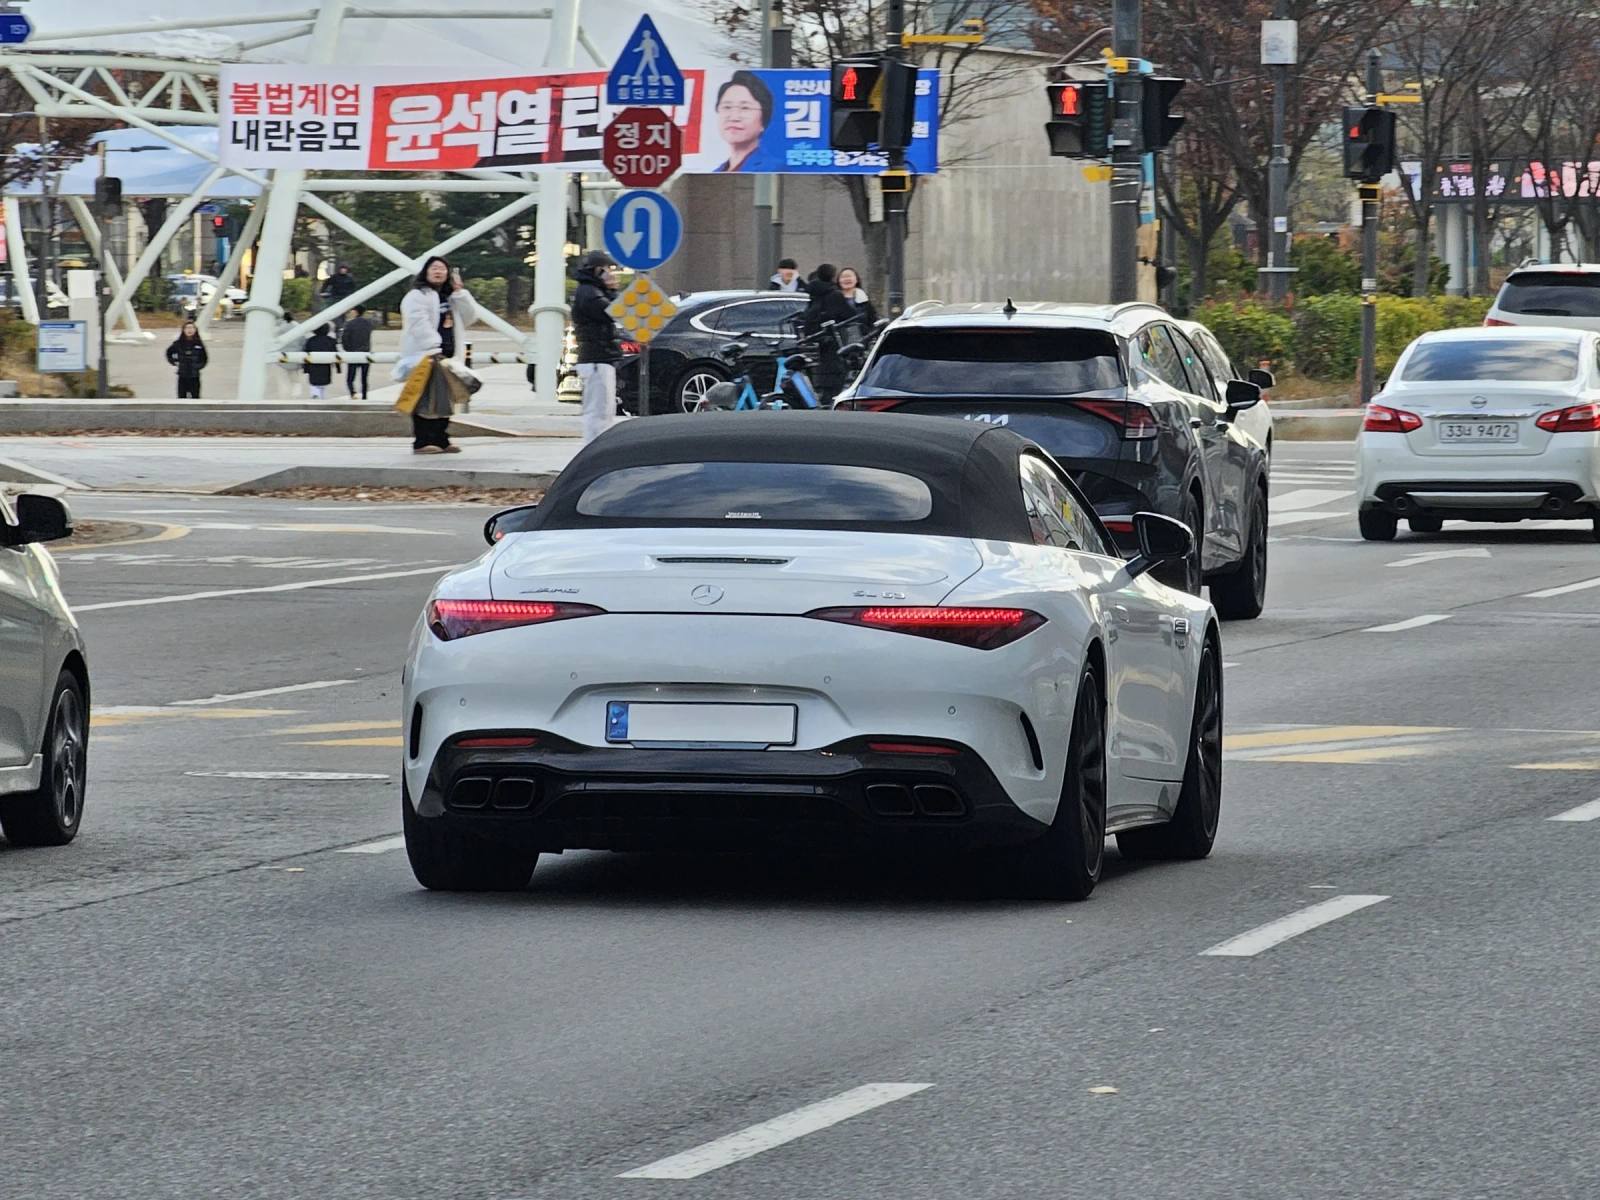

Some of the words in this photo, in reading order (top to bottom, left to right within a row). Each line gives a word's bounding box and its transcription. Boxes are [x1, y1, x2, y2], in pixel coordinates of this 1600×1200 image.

[229, 82, 361, 116] 불법계엄
[231, 119, 361, 152] 내란음모
[385, 86, 552, 163] 윤석열
[613, 122, 671, 149] 정지
[613, 154, 671, 175] STOP
[1477, 424, 1511, 438] 9472
